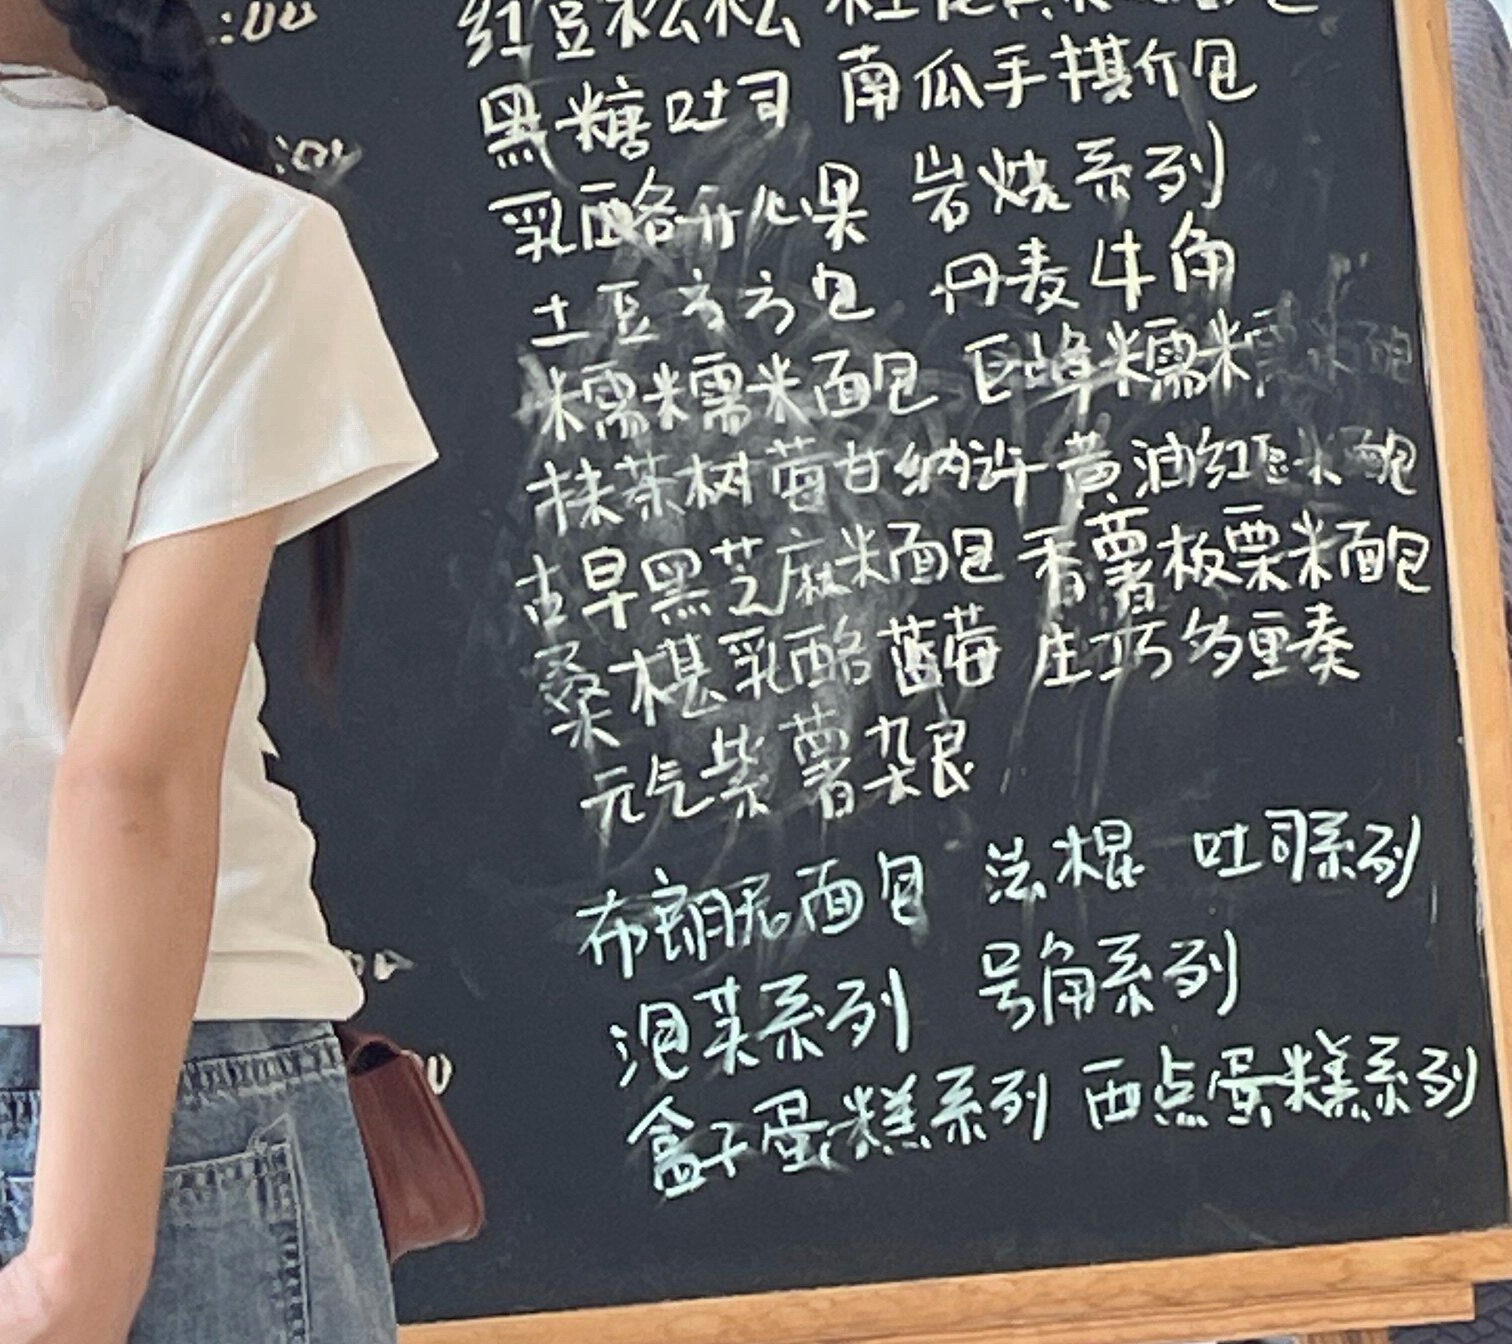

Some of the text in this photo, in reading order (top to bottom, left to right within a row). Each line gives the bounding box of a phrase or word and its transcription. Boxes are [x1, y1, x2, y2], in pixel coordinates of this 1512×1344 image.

[479, 69, 790, 169] 黑糖吐司
[931, 209, 1236, 315] 丹麦牛角
[985, 819, 1144, 904] 法棍
[610, 967, 910, 1087] 泡菜系列
